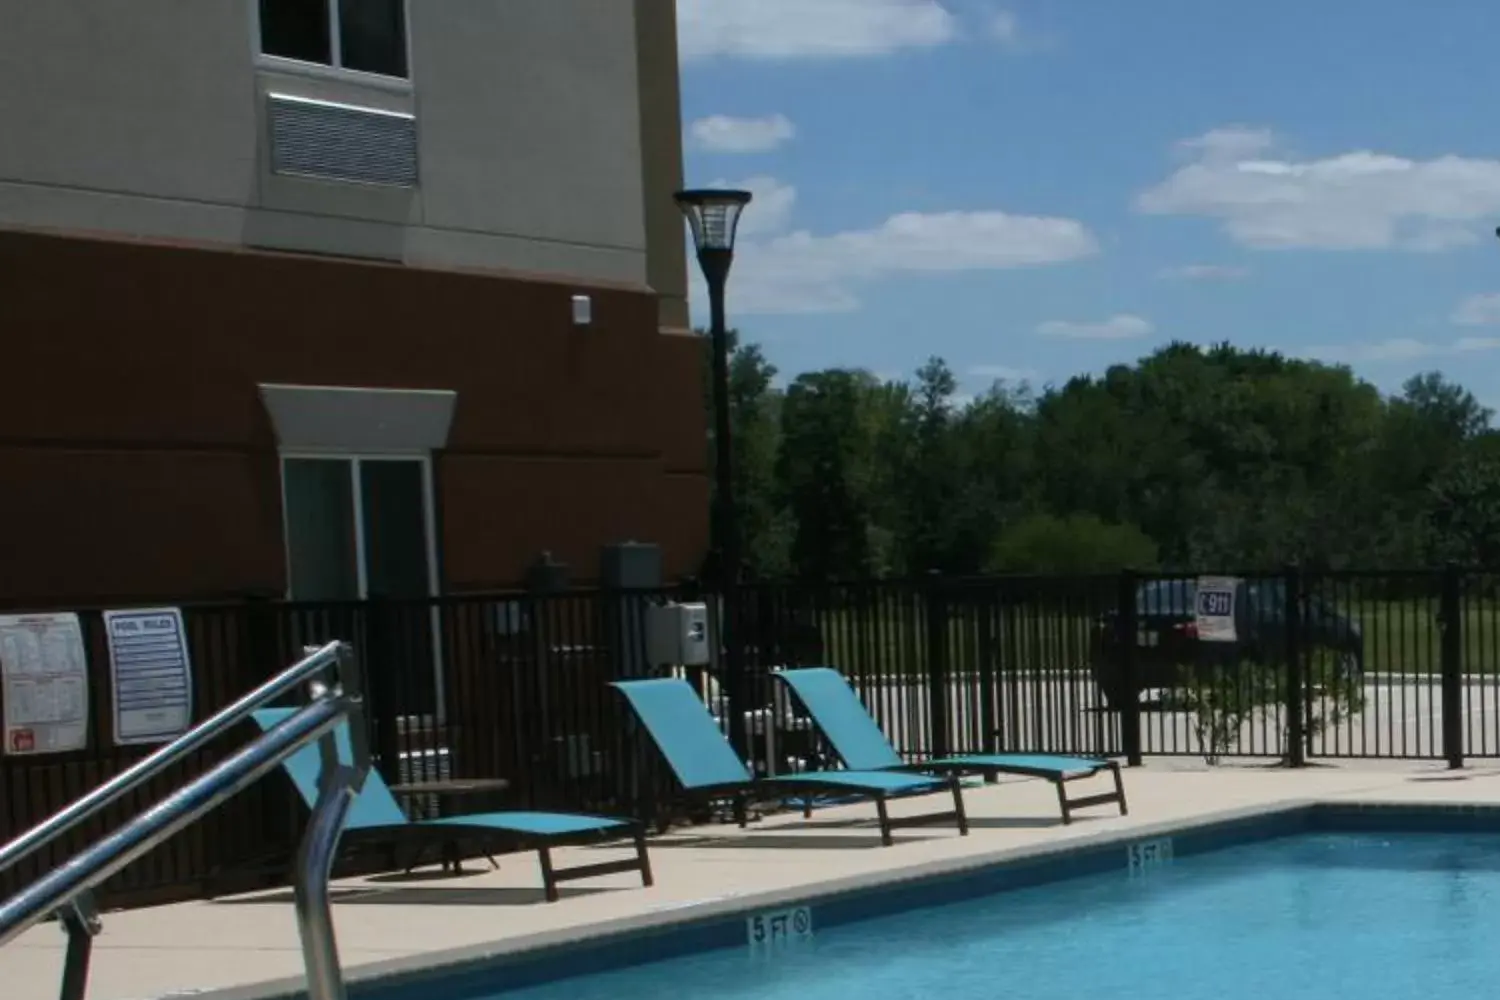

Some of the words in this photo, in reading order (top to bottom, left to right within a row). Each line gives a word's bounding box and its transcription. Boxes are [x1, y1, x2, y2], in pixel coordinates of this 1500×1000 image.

[1208, 593, 1229, 613] 911
[753, 916, 765, 942] 5
[770, 915, 787, 940] FT
